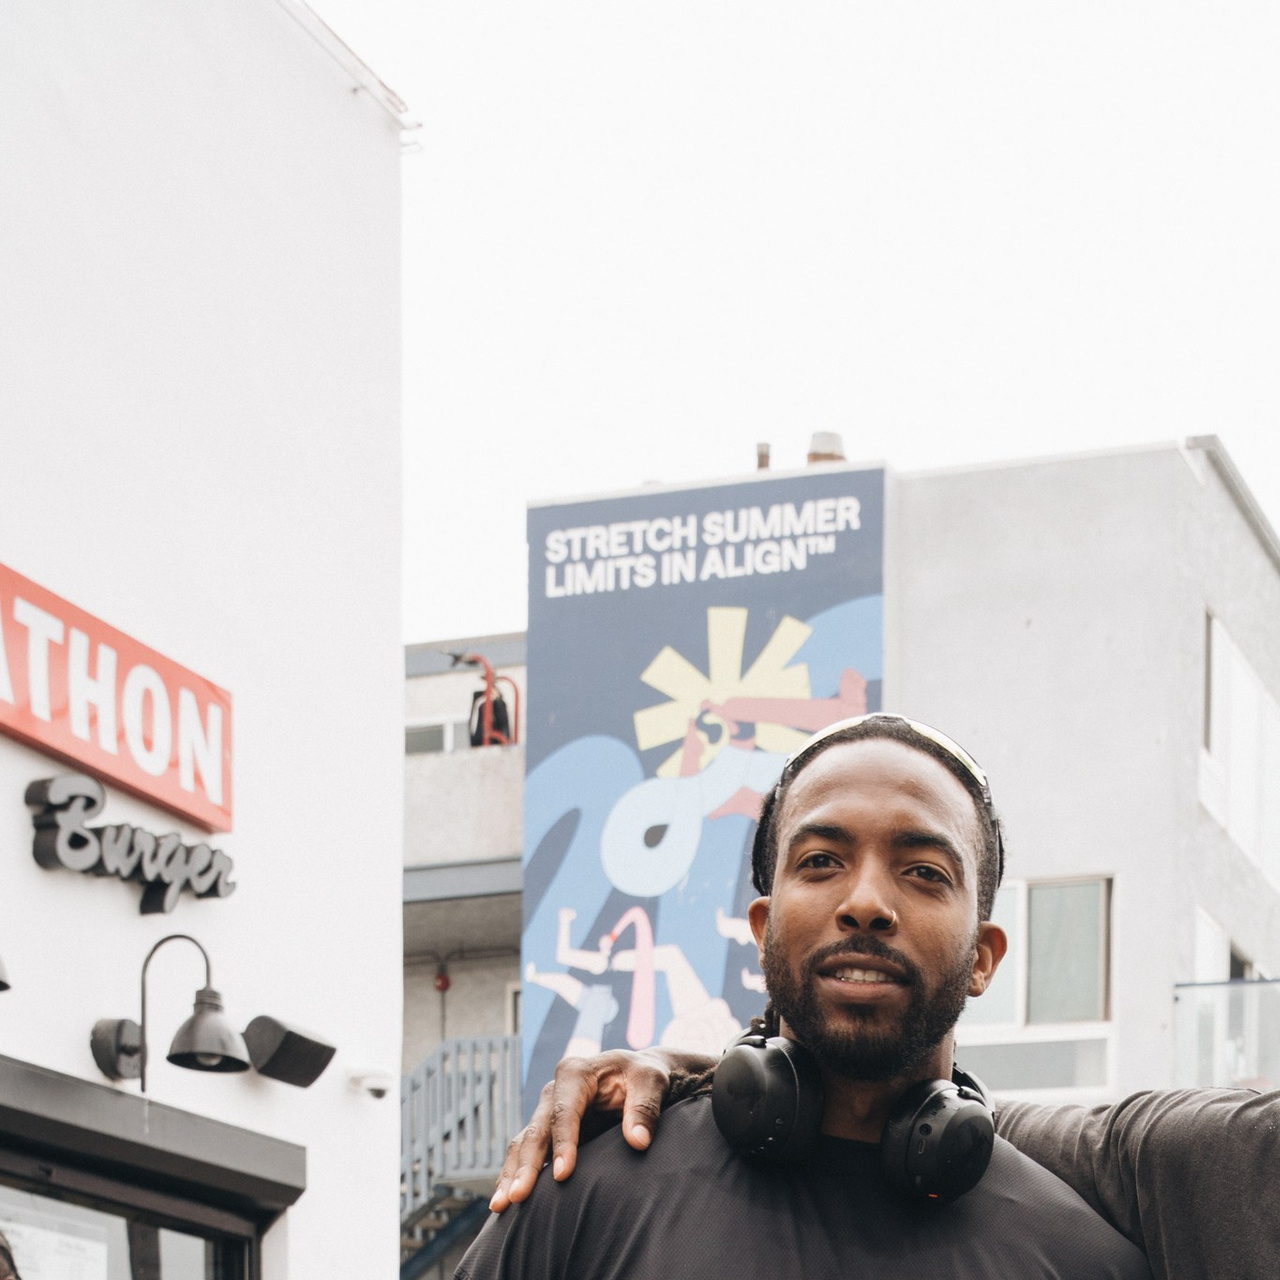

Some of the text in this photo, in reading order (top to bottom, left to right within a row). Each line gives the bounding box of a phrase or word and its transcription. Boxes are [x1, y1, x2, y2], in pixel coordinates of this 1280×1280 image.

[545, 496, 860, 563] STRETCH SUMMER
[545, 554, 657, 598] LIMITS
[661, 550, 696, 585] IN
[26, 773, 236, 914] Burger
